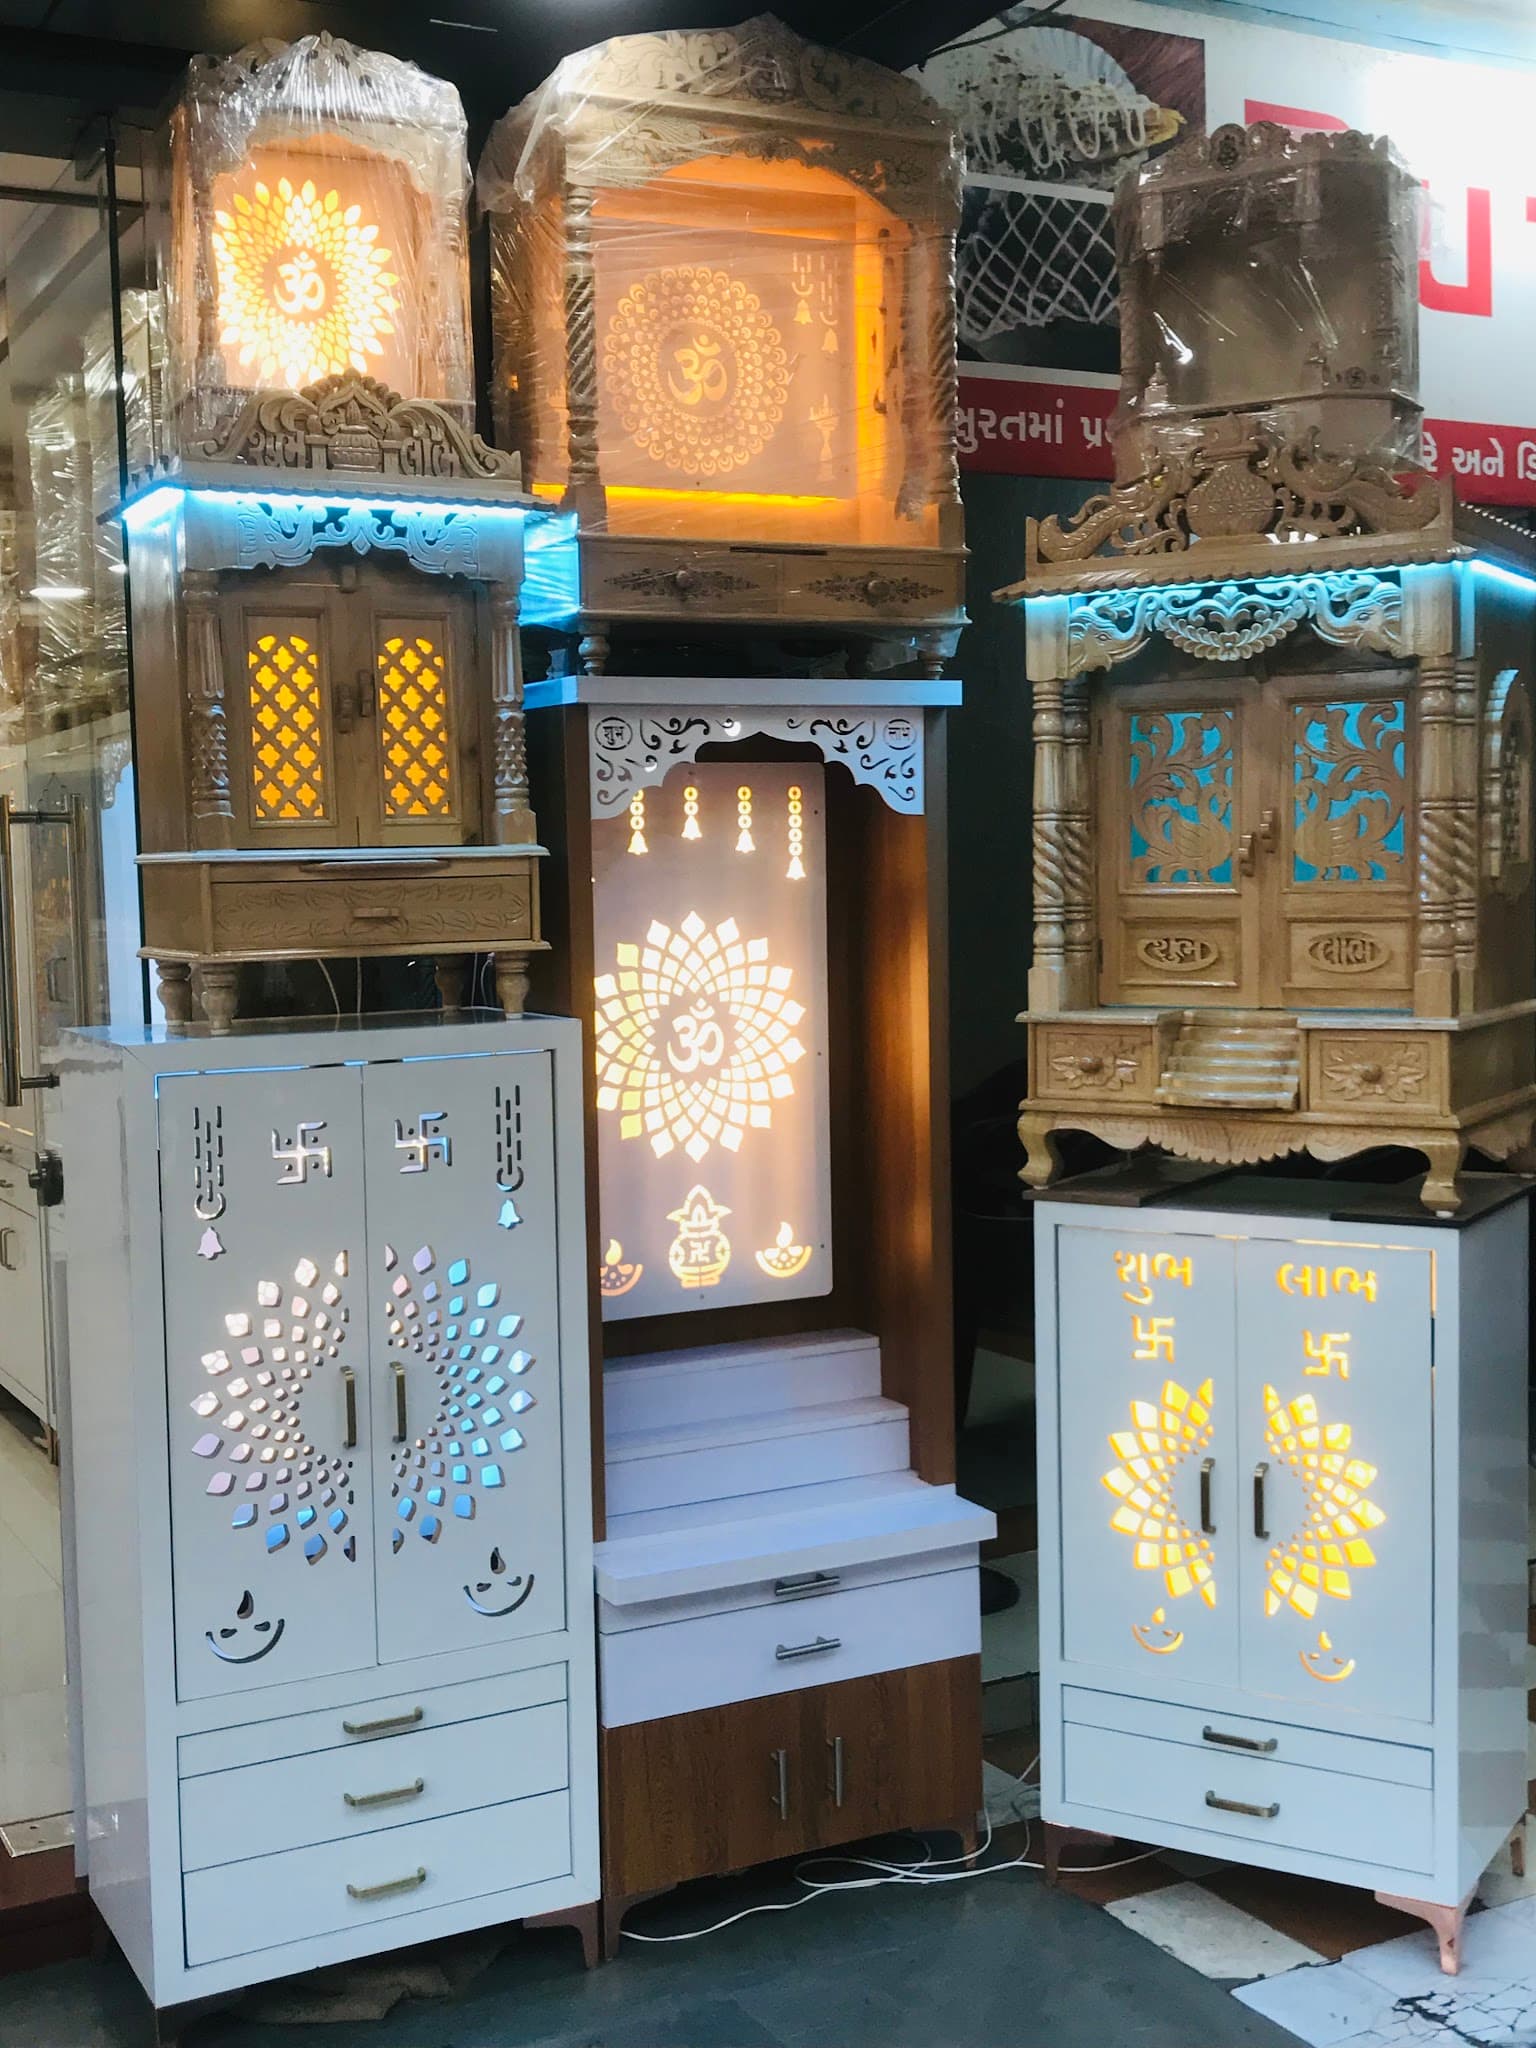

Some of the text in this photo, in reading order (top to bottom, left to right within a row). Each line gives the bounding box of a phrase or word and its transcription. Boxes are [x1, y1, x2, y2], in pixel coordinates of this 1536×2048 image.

[948, 398, 1112, 454] સુરતમાં પ્ર
[1452, 437, 1504, 478] અને
[1113, 1249, 1377, 1305] શુભ લાભ
